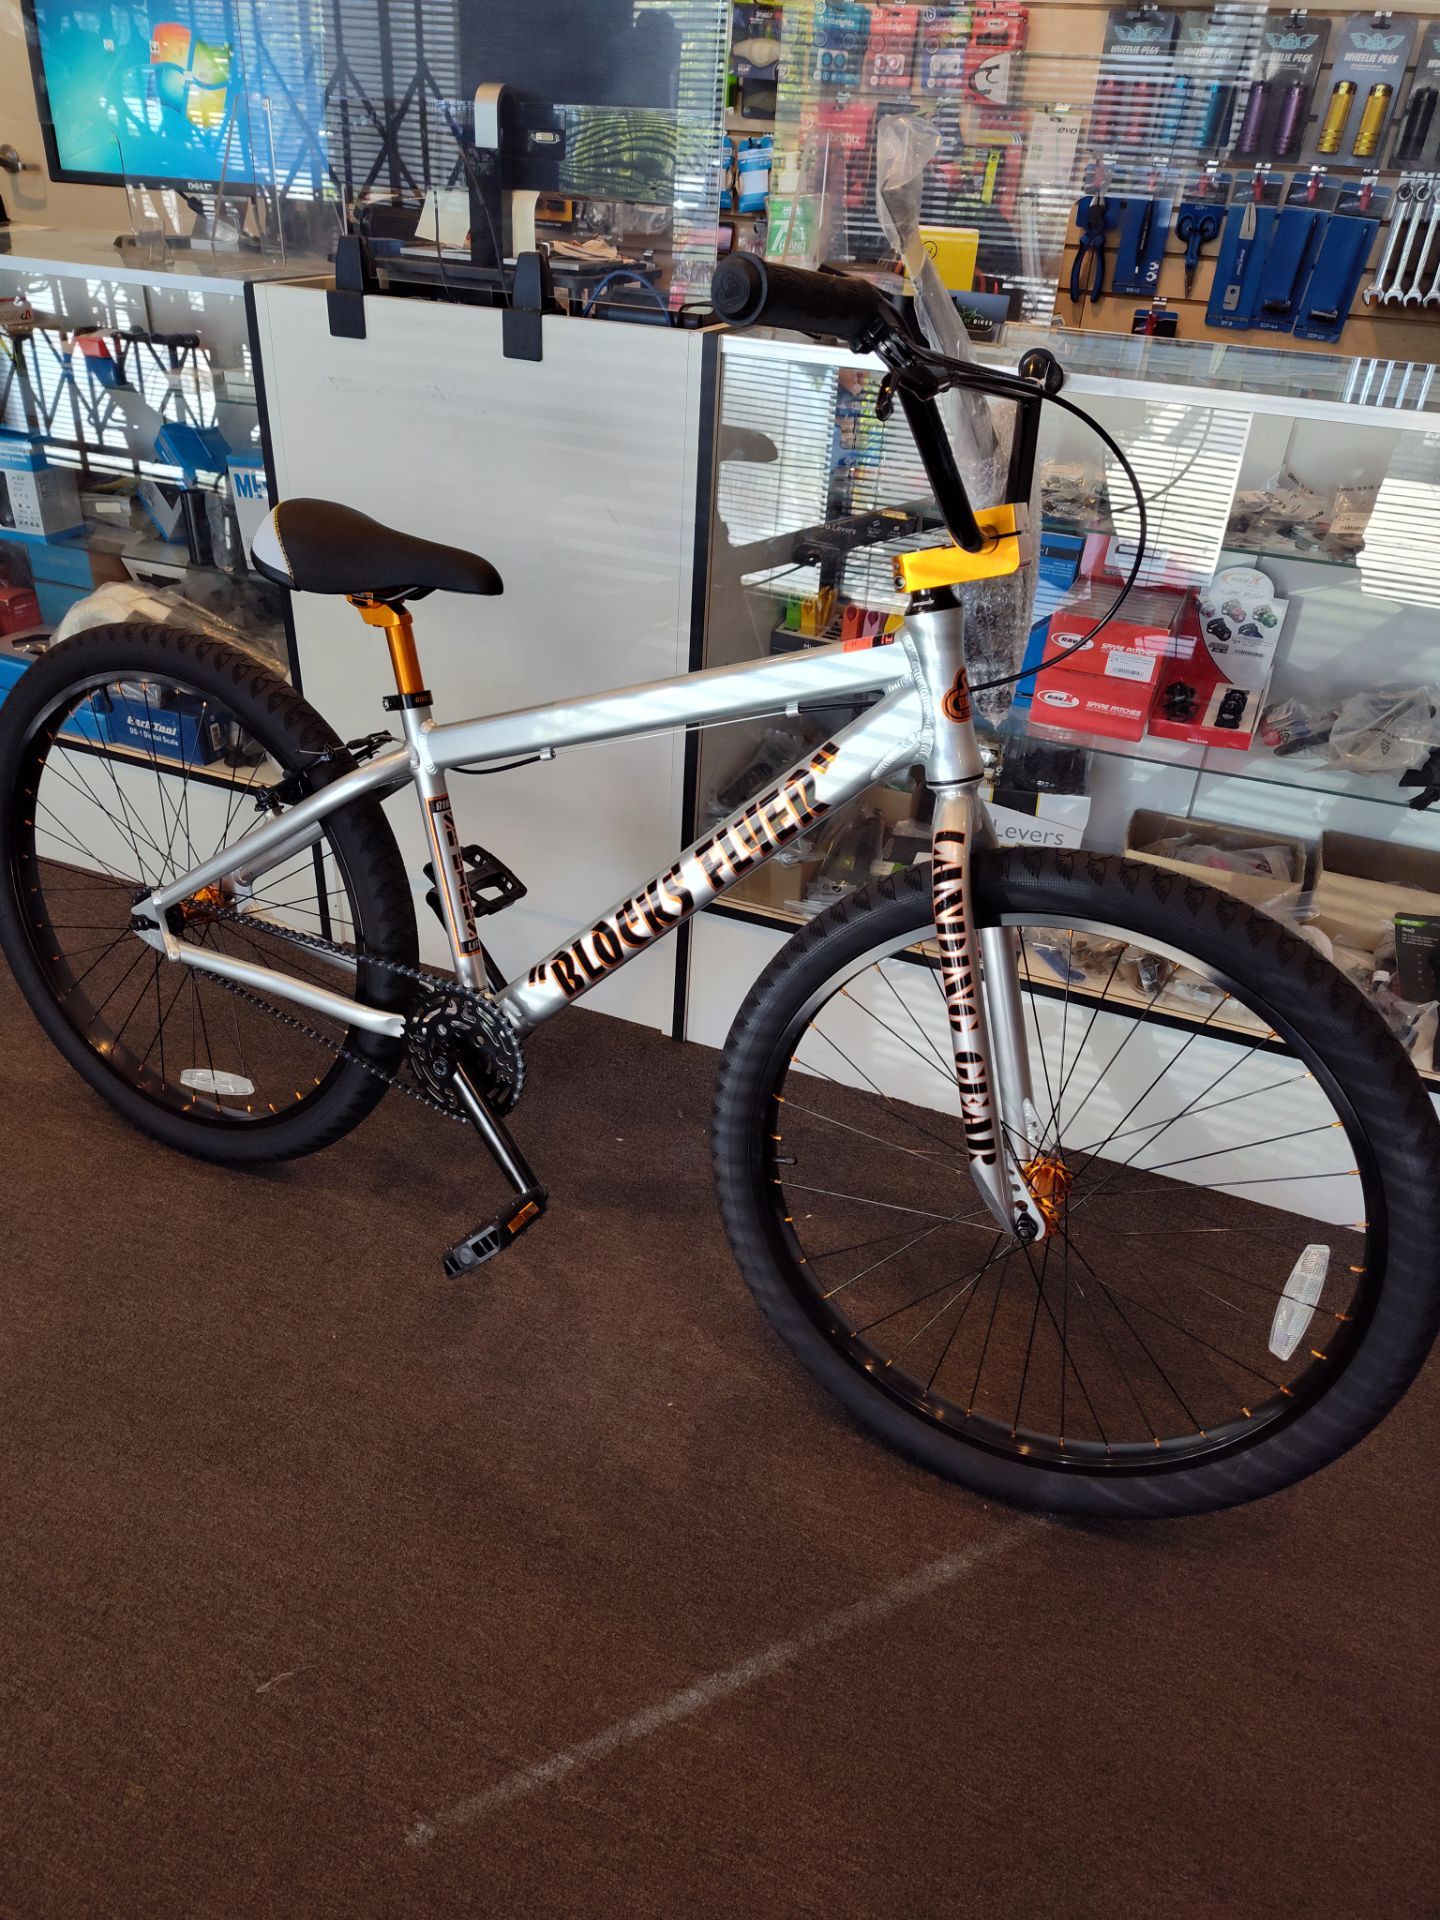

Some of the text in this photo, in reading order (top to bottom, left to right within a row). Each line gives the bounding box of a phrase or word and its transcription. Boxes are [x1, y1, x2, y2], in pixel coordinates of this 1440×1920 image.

[1110, 45, 1160, 55] WHEELIE PEGS
[1260, 51, 1313, 63] WHEELIE PEGS
[1344, 51, 1399, 64] WHEELIE PEGS
[1101, 642, 1125, 652] SPARE
[1086, 700, 1110, 711] SPARE
[1110, 705, 1142, 717] PATCHES
[153, 723, 177, 736] Tool
[162, 735, 179, 747] Scale
[993, 818, 1065, 847] Levers
[932, 830, 997, 1167] LANDING GEAR
